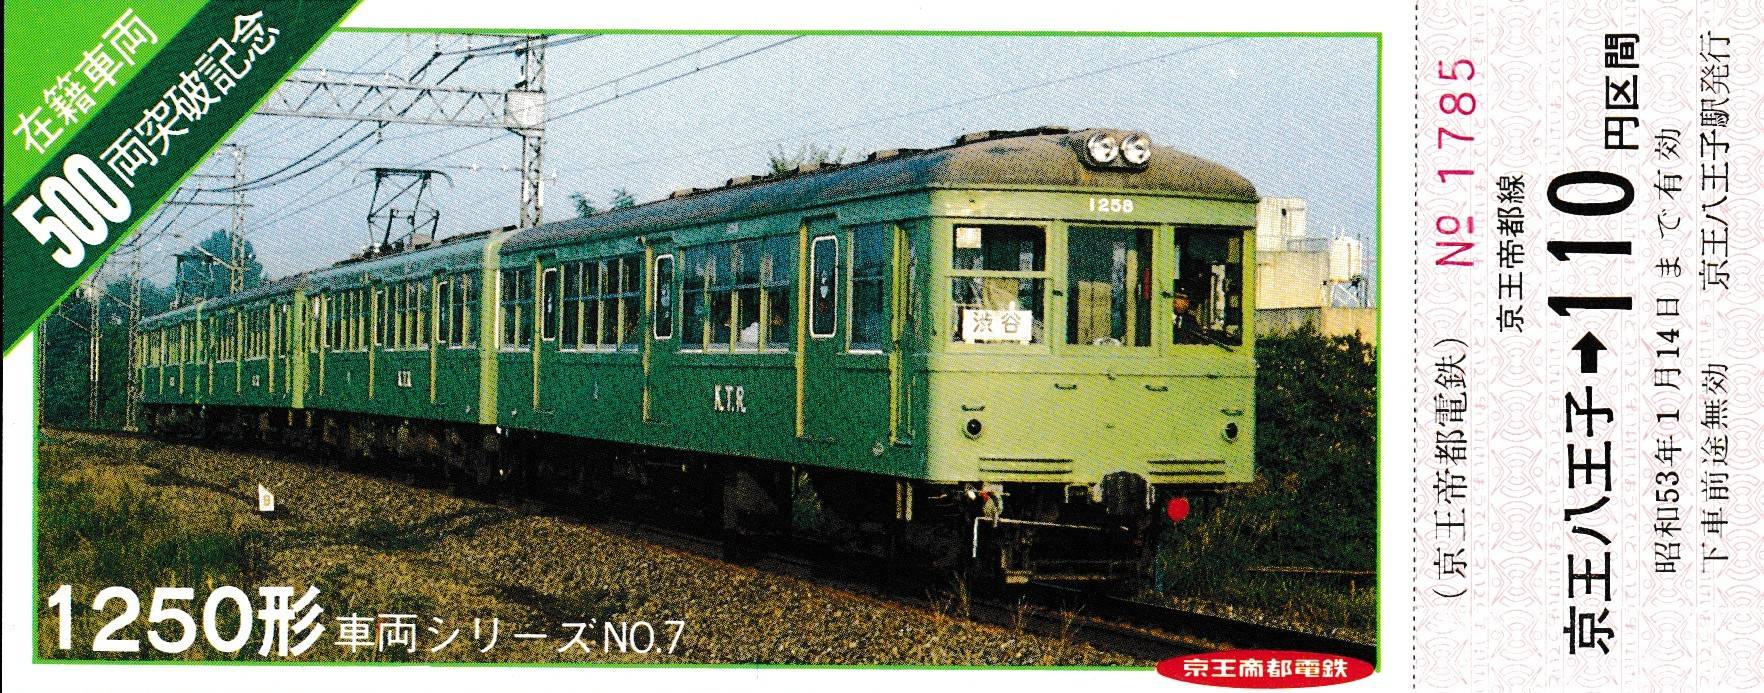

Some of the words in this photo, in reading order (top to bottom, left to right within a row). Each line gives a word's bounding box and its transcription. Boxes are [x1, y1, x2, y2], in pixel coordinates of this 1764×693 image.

[12, 8, 159, 155] 在籍車両
[1437, 58, 1477, 184] 1785
[1088, 197, 1134, 213] 1258
[1698, 30, 1731, 291] 京王八王子駅発行
[1496, 174, 1526, 333] 京王帝都線
[972, 312, 1021, 334] 渋谷
[1562, 386, 1615, 655] 京王八王子
[1700, 363, 1729, 574] 下車前途無効
[48, 584, 326, 657] 1250形
[1183, 658, 1347, 678] 京王帝都電鉄
